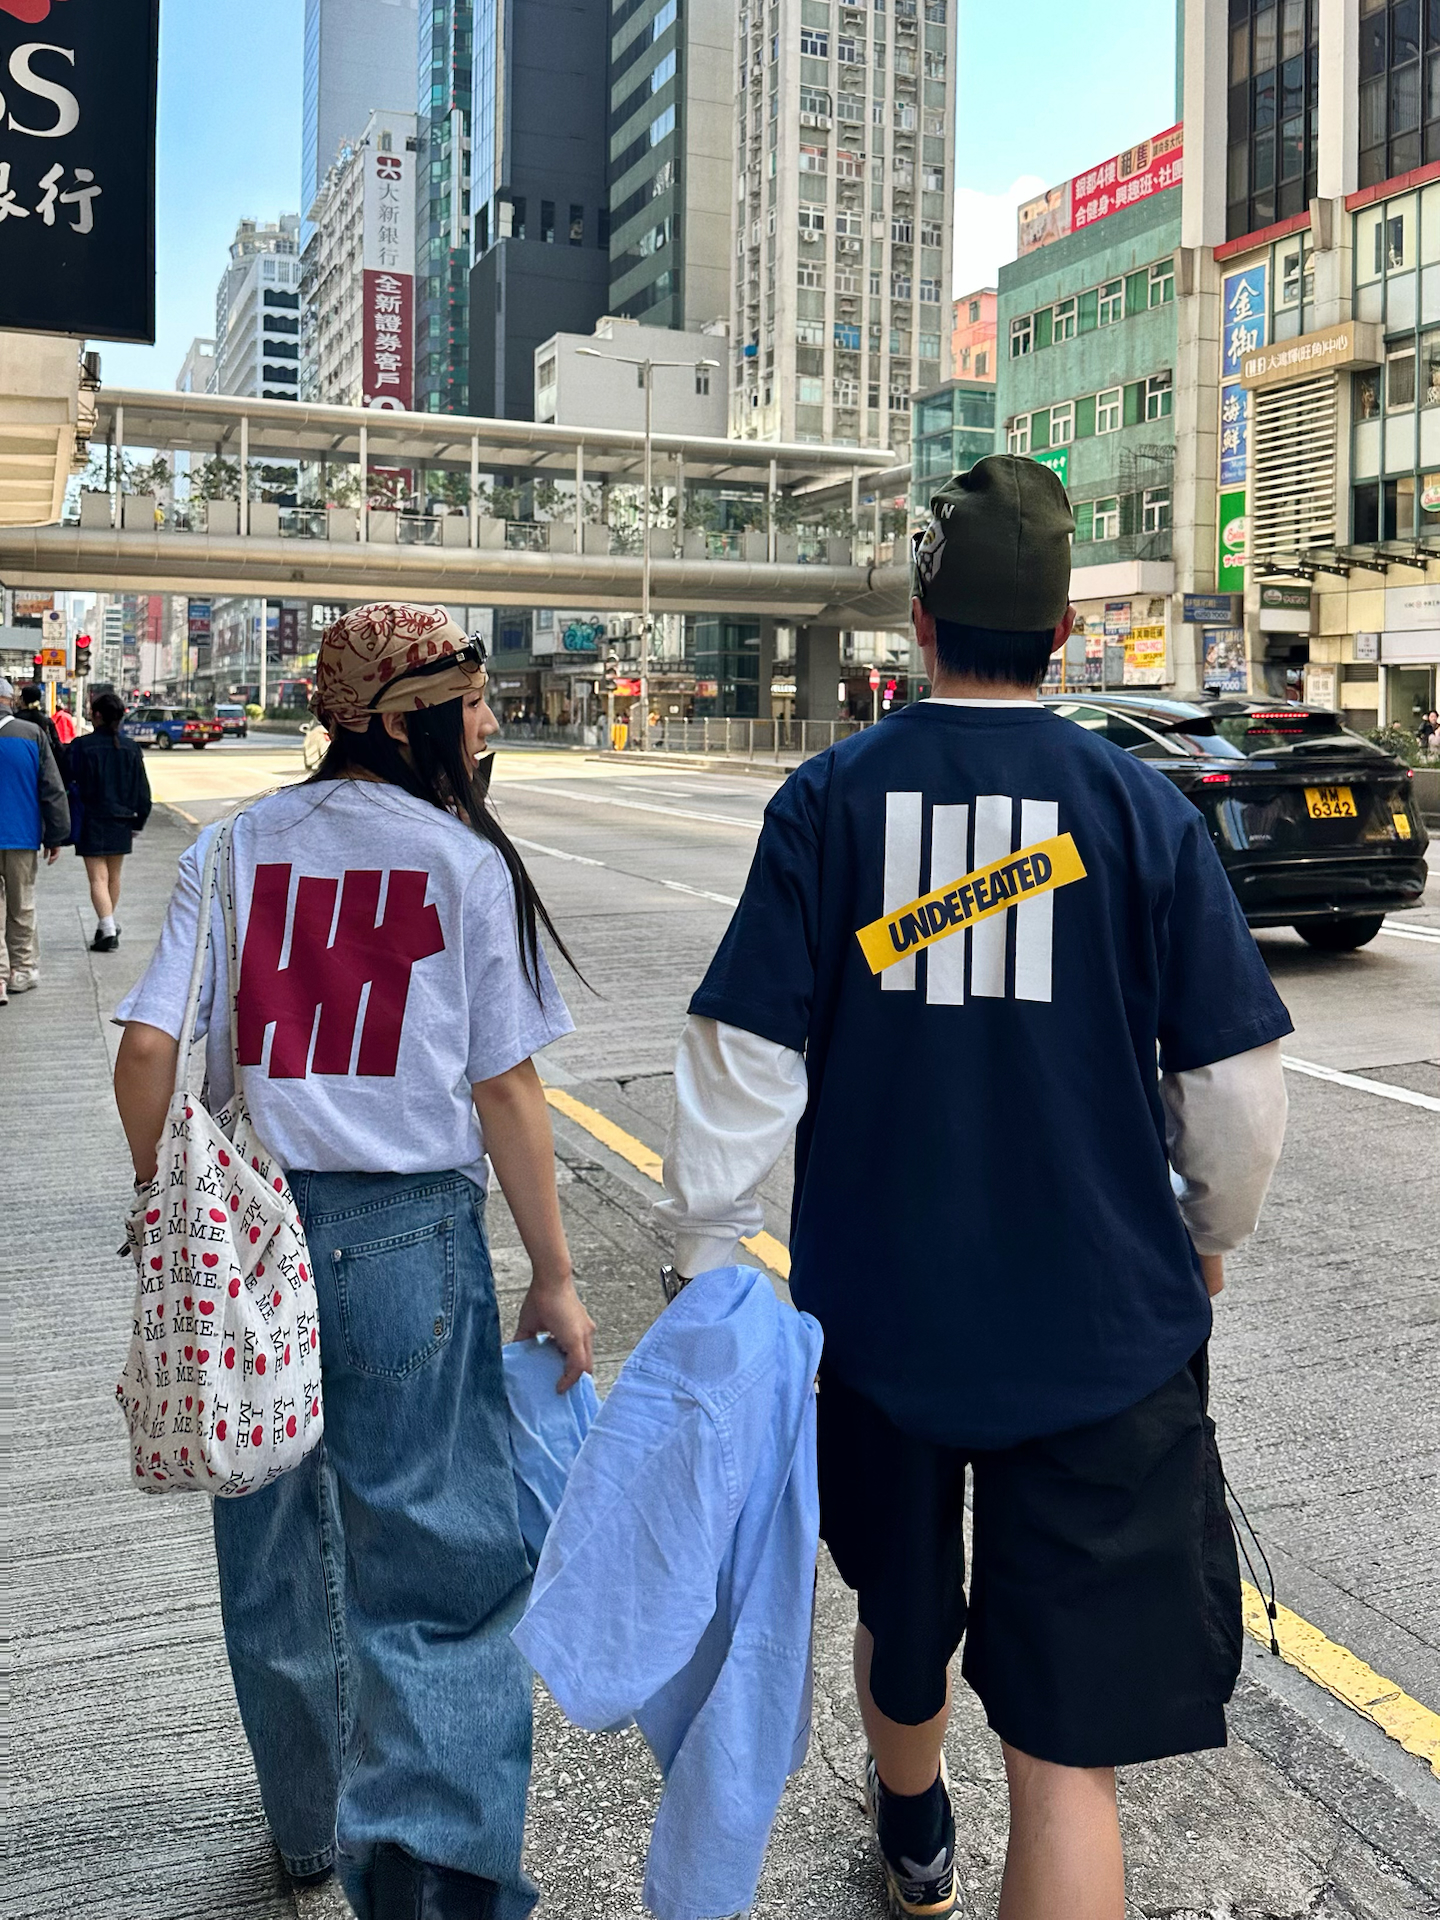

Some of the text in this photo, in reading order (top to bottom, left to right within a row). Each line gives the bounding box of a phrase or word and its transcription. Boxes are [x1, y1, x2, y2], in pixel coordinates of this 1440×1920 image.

[0, 42, 80, 138] S
[1121, 143, 1148, 178] 租/售
[378, 184, 400, 267] 大新銀行
[374, 275, 402, 389] 全新證券客戶
[1312, 802, 1353, 818] 6342
[888, 852, 1052, 953] UNDEFEATED
